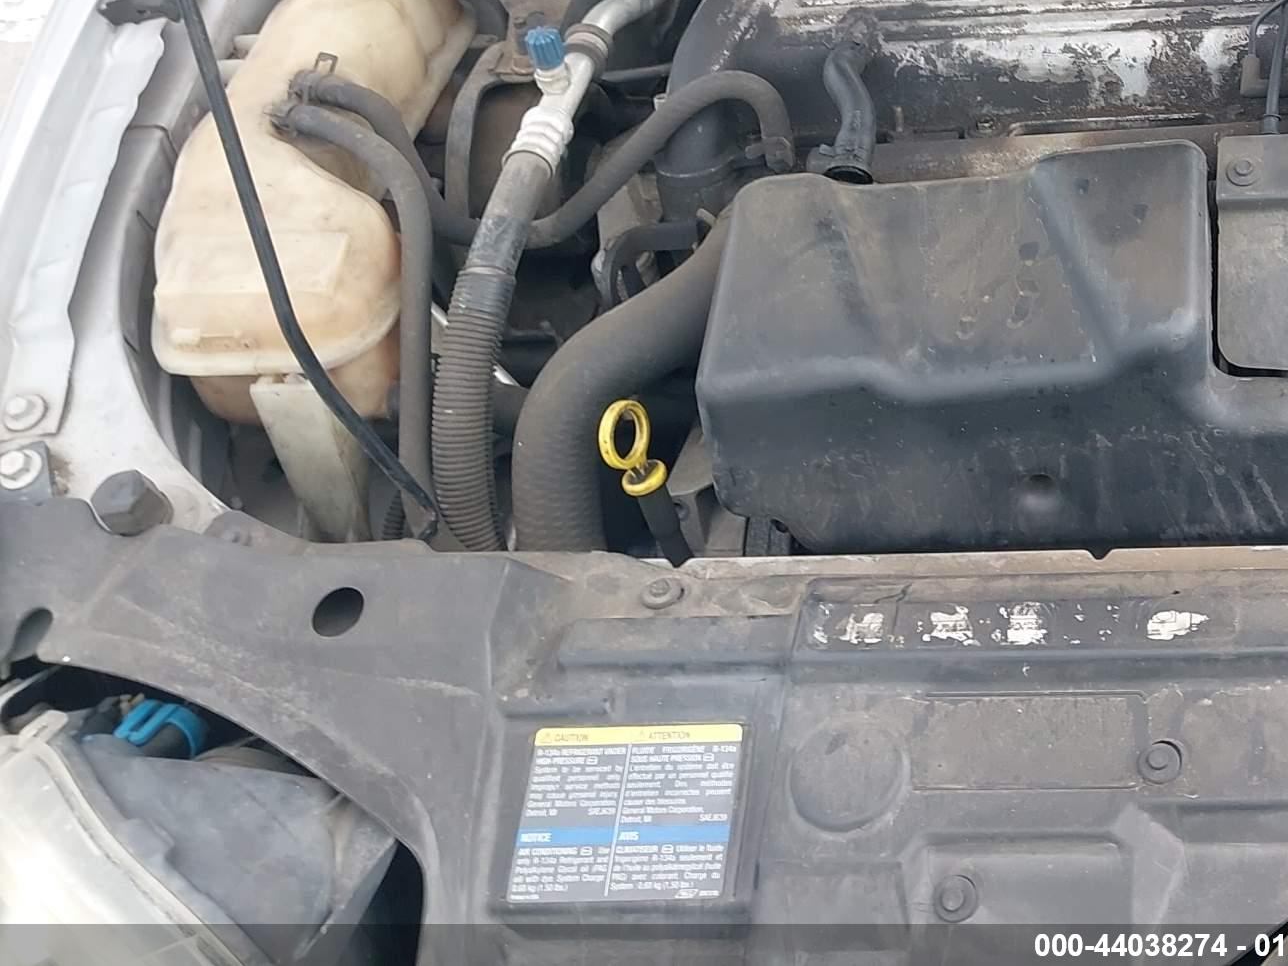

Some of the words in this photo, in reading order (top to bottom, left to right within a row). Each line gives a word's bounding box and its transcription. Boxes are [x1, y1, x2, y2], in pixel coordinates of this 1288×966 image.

[554, 733, 589, 742] CAUTION
[648, 731, 691, 740] ATTENTION
[520, 832, 553, 843] NOTICE
[618, 831, 639, 841] AVIS
